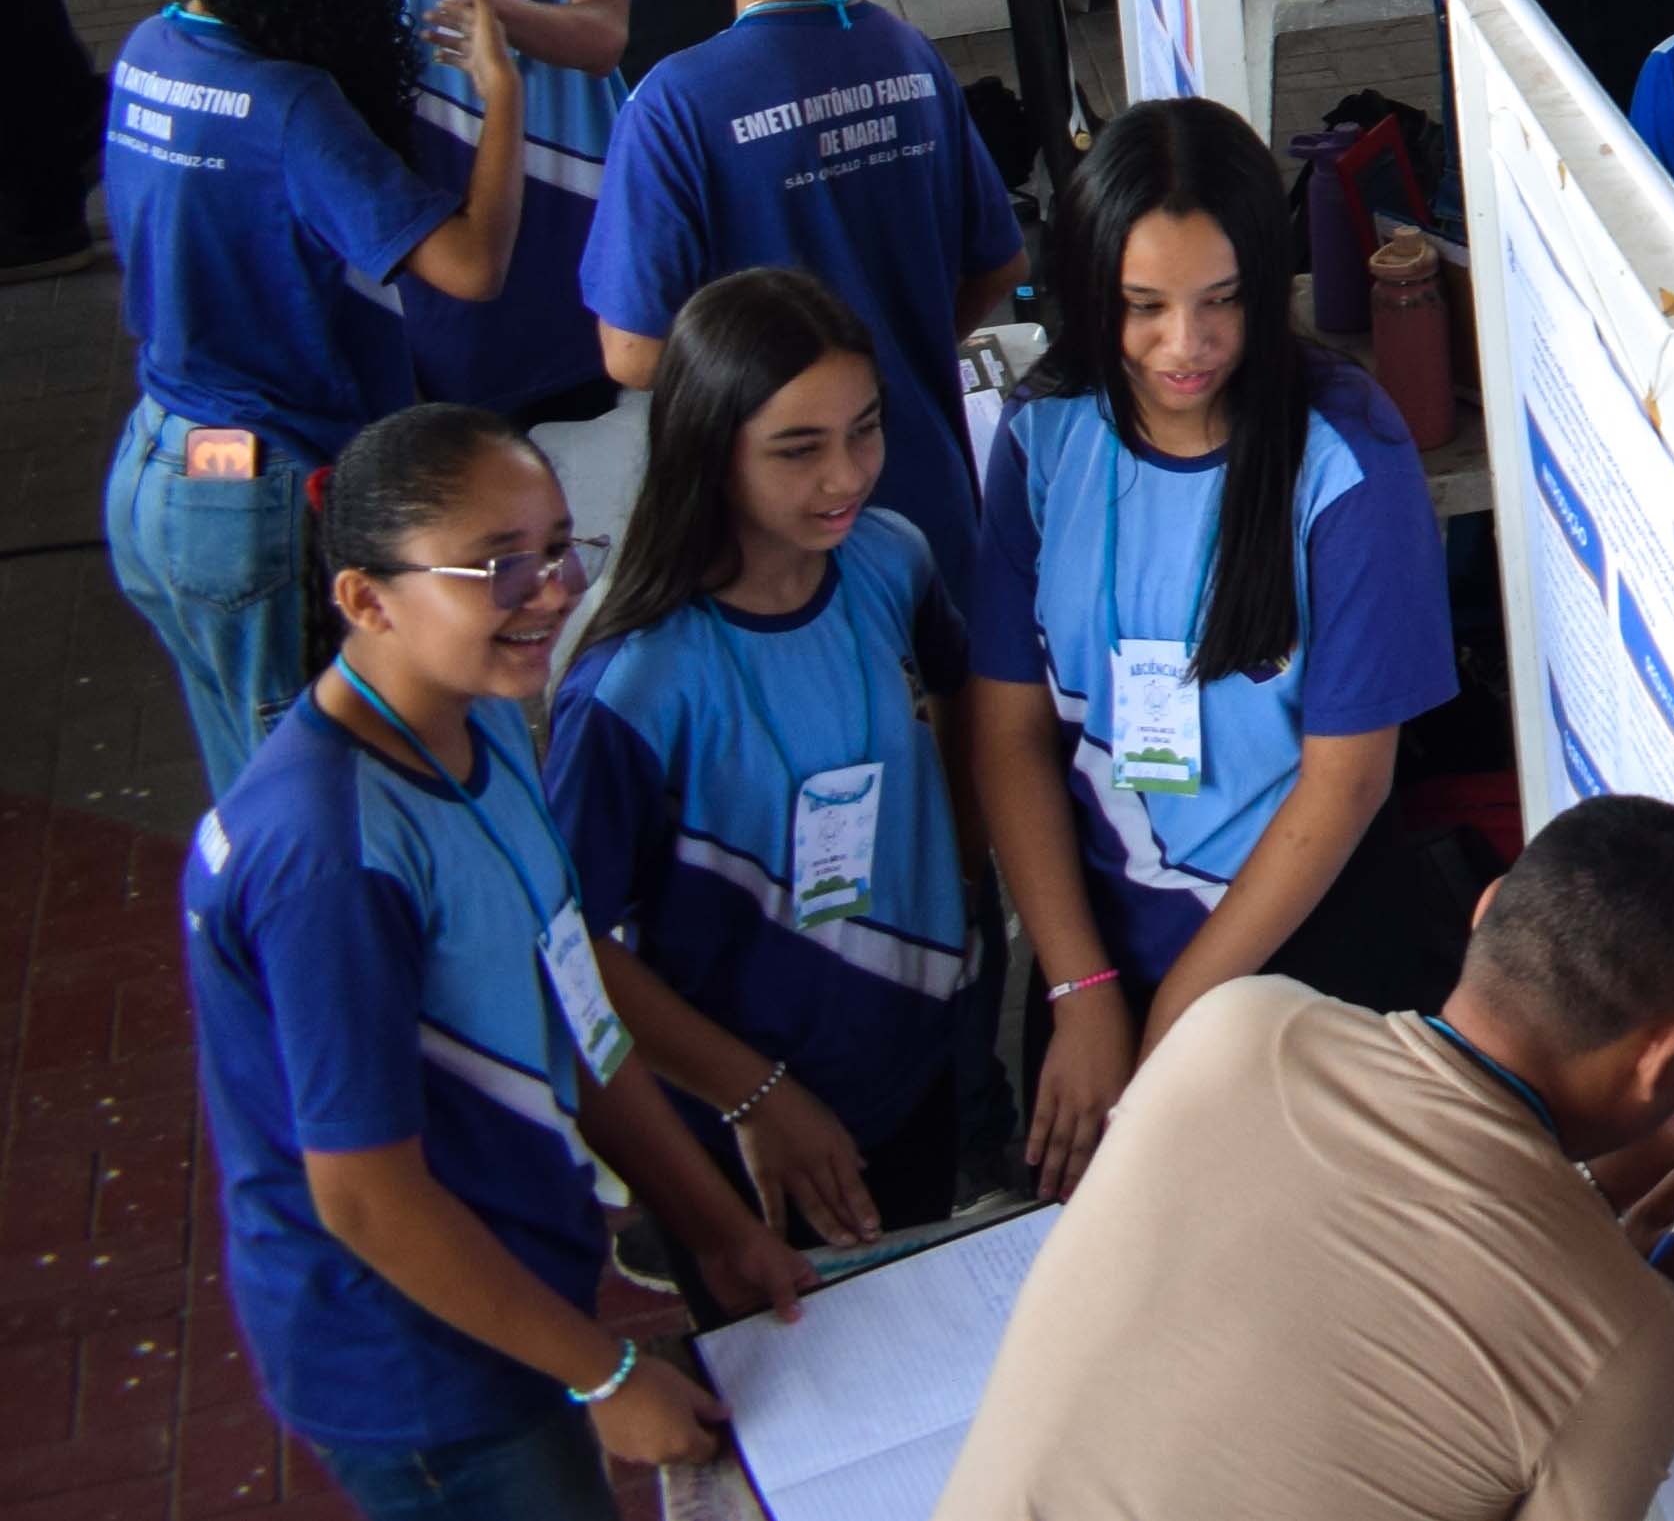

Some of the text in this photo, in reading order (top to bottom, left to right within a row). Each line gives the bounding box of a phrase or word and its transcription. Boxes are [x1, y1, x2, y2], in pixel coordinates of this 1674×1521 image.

[167, 81, 251, 119] FAUSTINO
[731, 101, 803, 144] EMETI
[802, 83, 874, 125] ANTÔNIO
[819, 129, 841, 158] DE
[785, 172, 815, 190] SÃO
